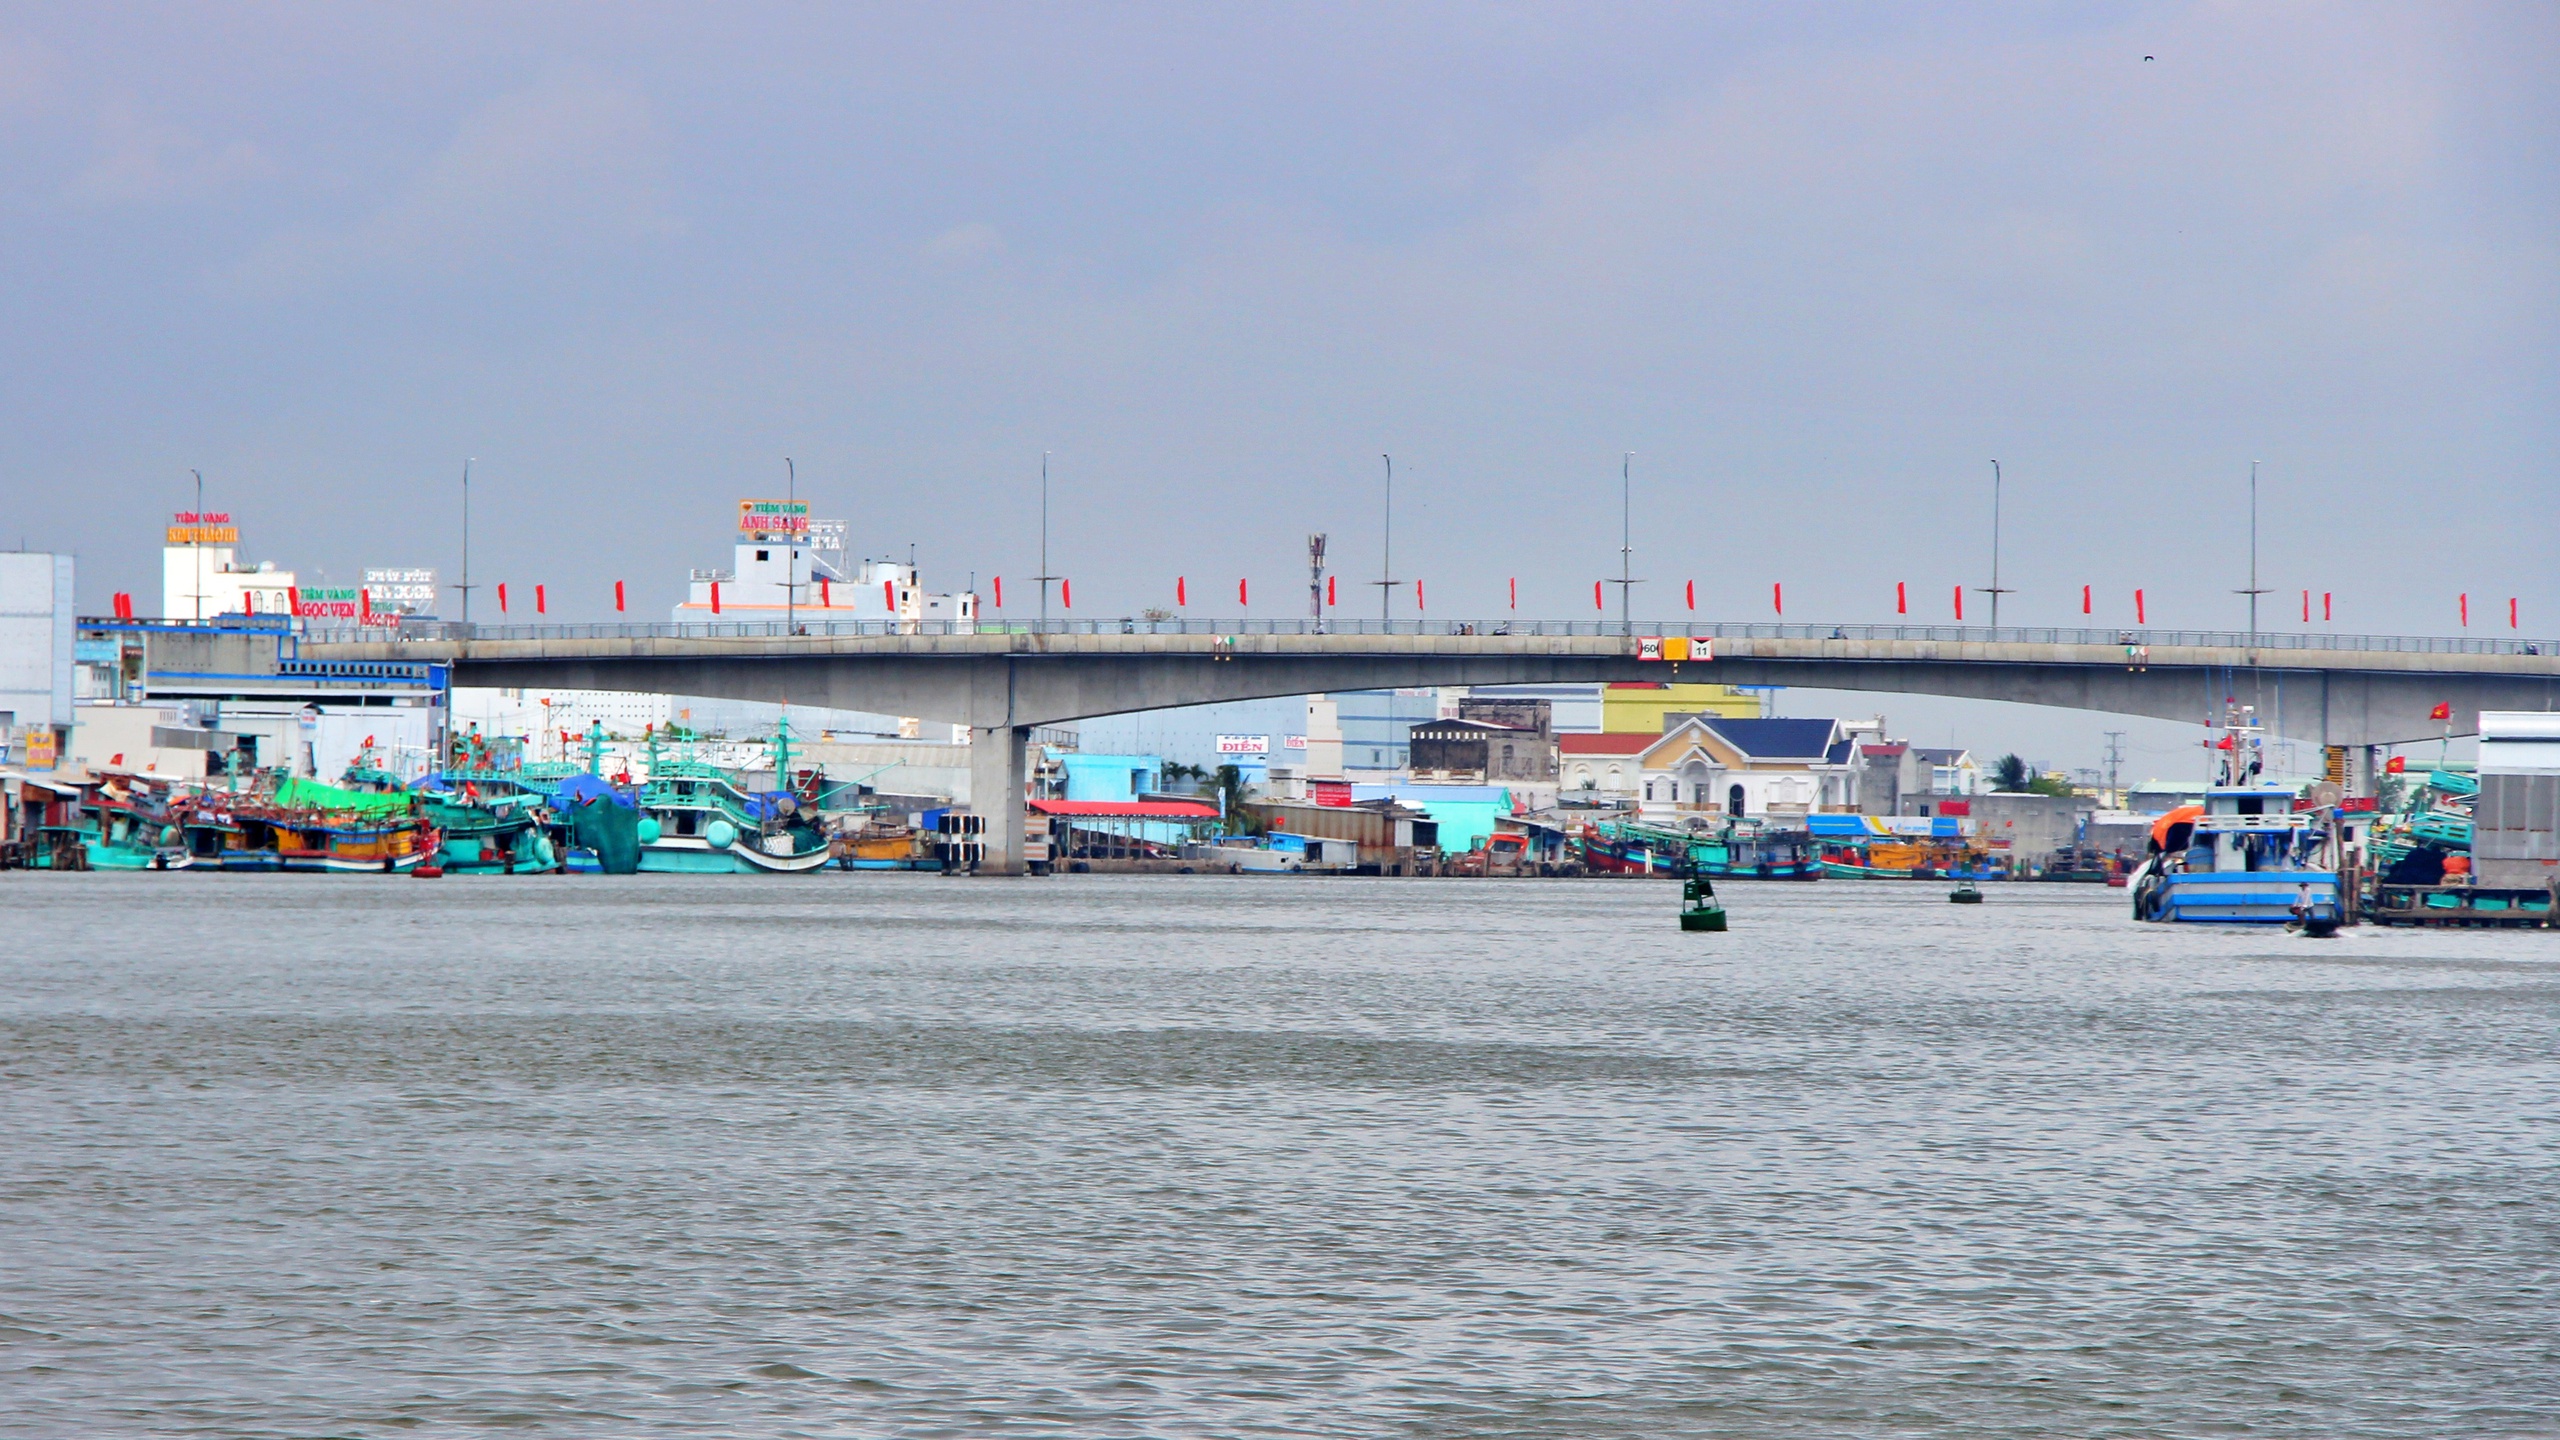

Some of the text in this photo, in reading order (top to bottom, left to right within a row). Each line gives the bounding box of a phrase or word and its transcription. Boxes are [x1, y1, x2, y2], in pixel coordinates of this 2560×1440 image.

[755, 502, 780, 514] TIỆM
[301, 586, 356, 600] TIỆM VÀNG
[330, 602, 356, 620] VẸN
[1643, 644, 1657, 653] 60
[1696, 647, 1707, 656] 11
